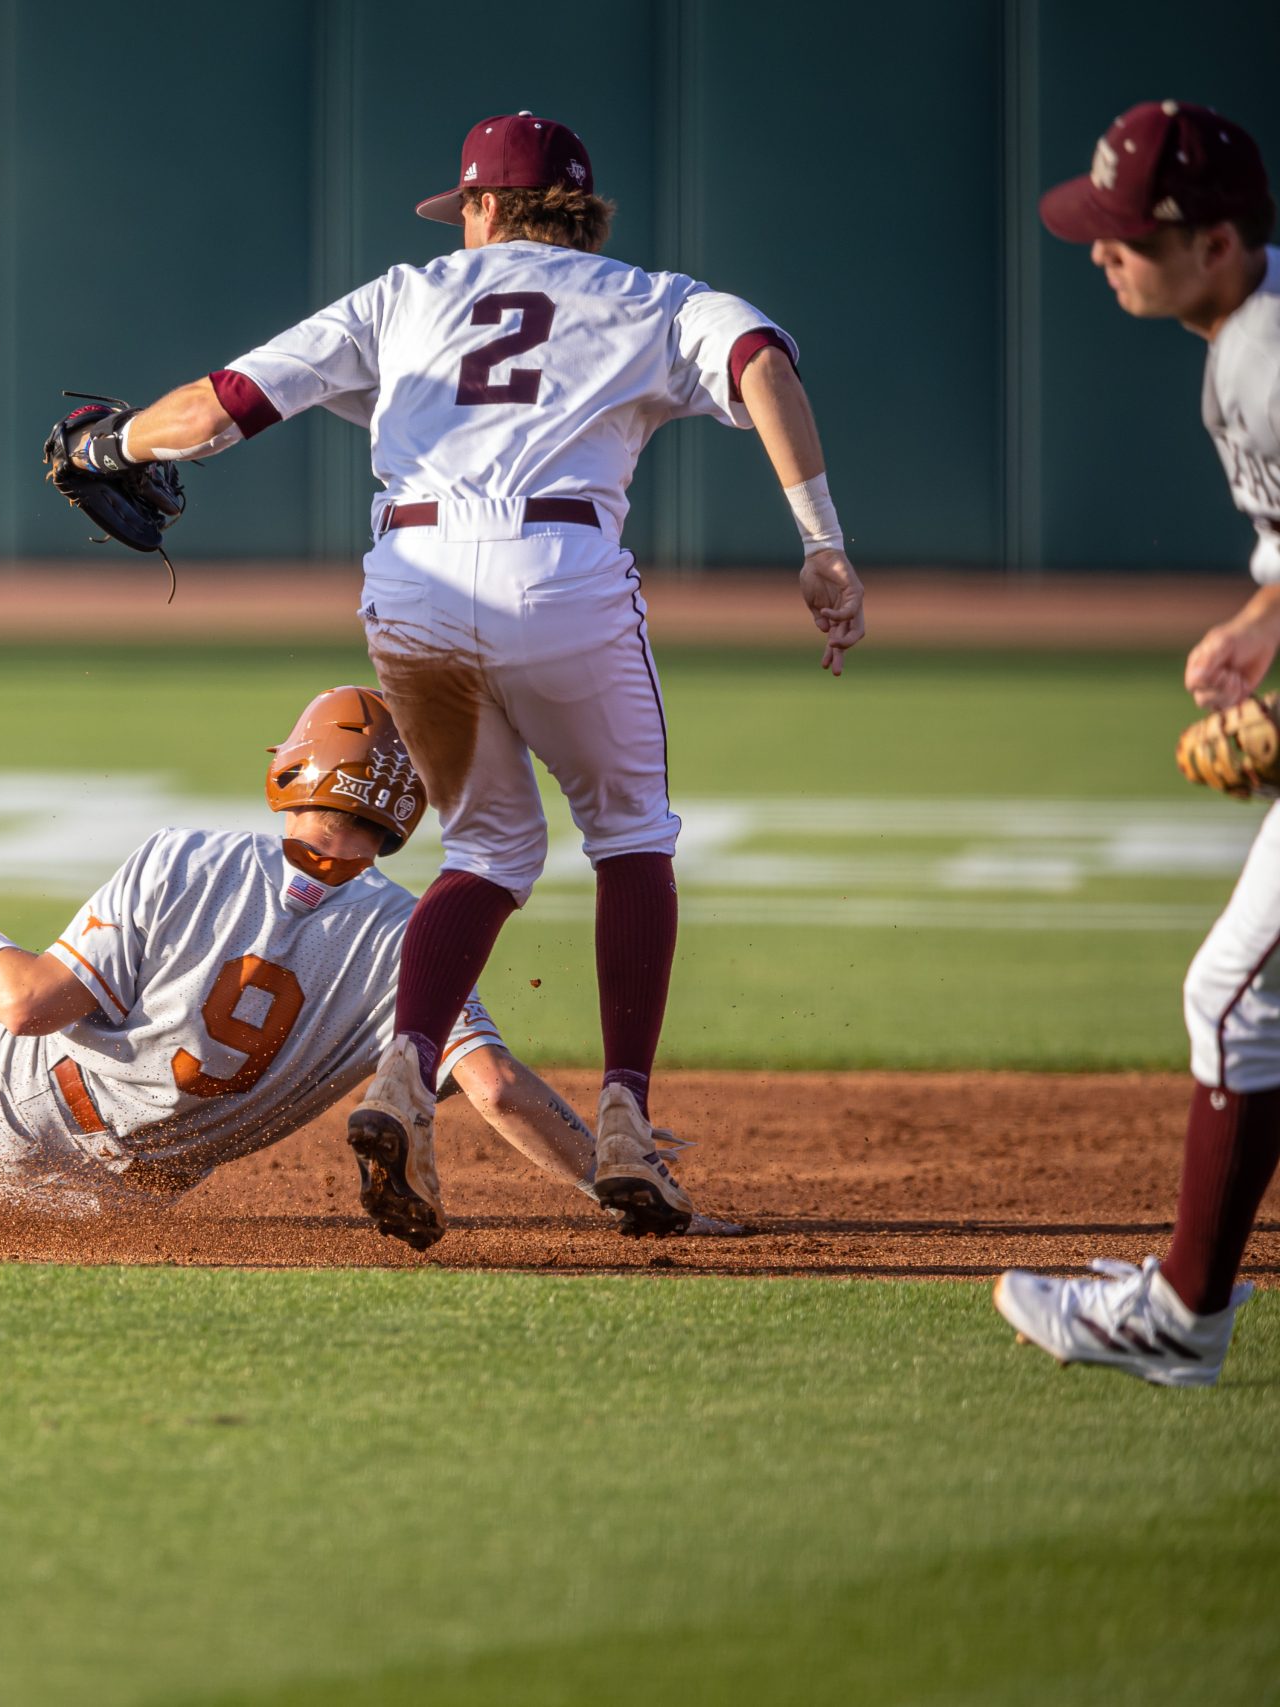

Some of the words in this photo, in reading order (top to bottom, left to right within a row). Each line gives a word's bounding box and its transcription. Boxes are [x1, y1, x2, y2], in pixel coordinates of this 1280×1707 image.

[454, 291, 557, 406] 2
[375, 788, 391, 808] 9
[171, 953, 306, 1098] 9
